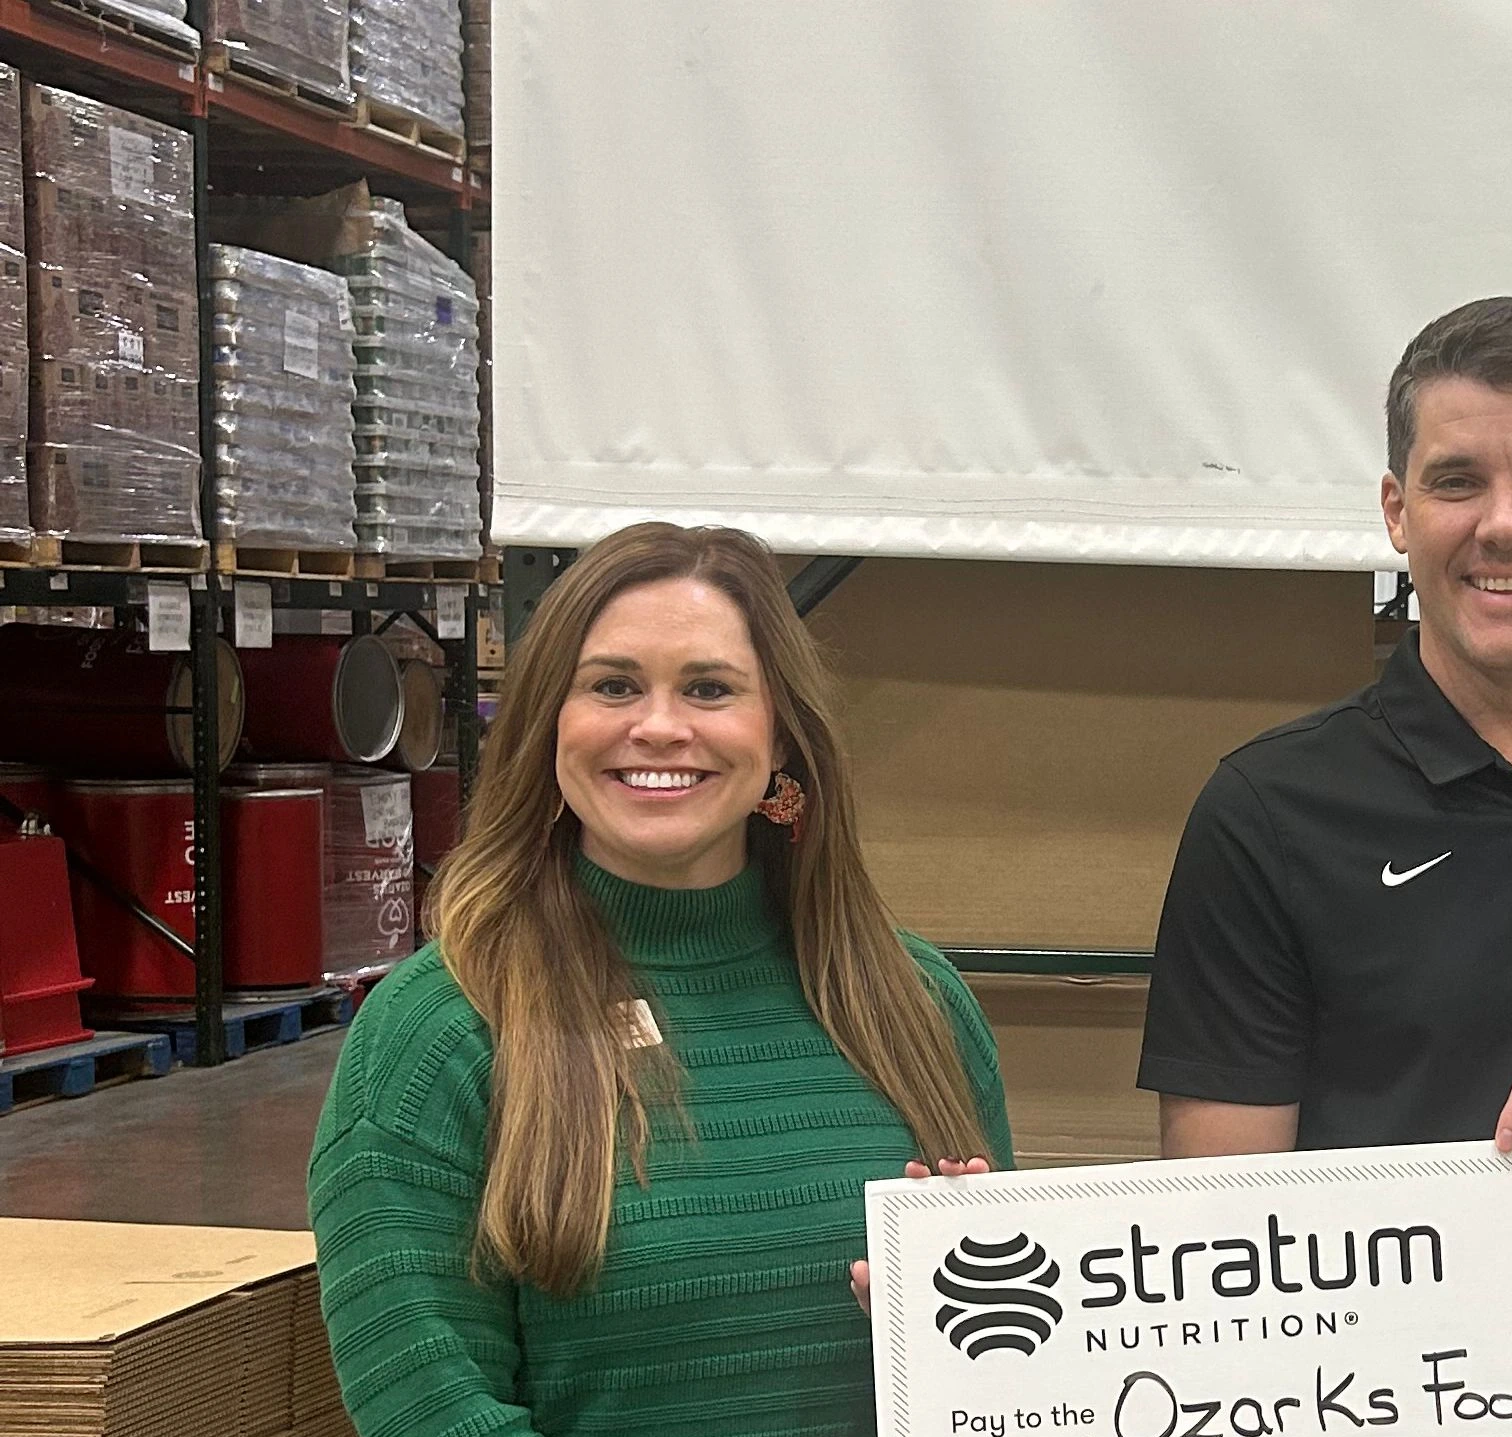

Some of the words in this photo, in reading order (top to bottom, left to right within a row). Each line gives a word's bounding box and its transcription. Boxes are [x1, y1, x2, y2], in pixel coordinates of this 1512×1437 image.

[1080, 1213, 1443, 1309] stratum
[1013, 1408, 1042, 1429] to
[1050, 1402, 1095, 1427] the
